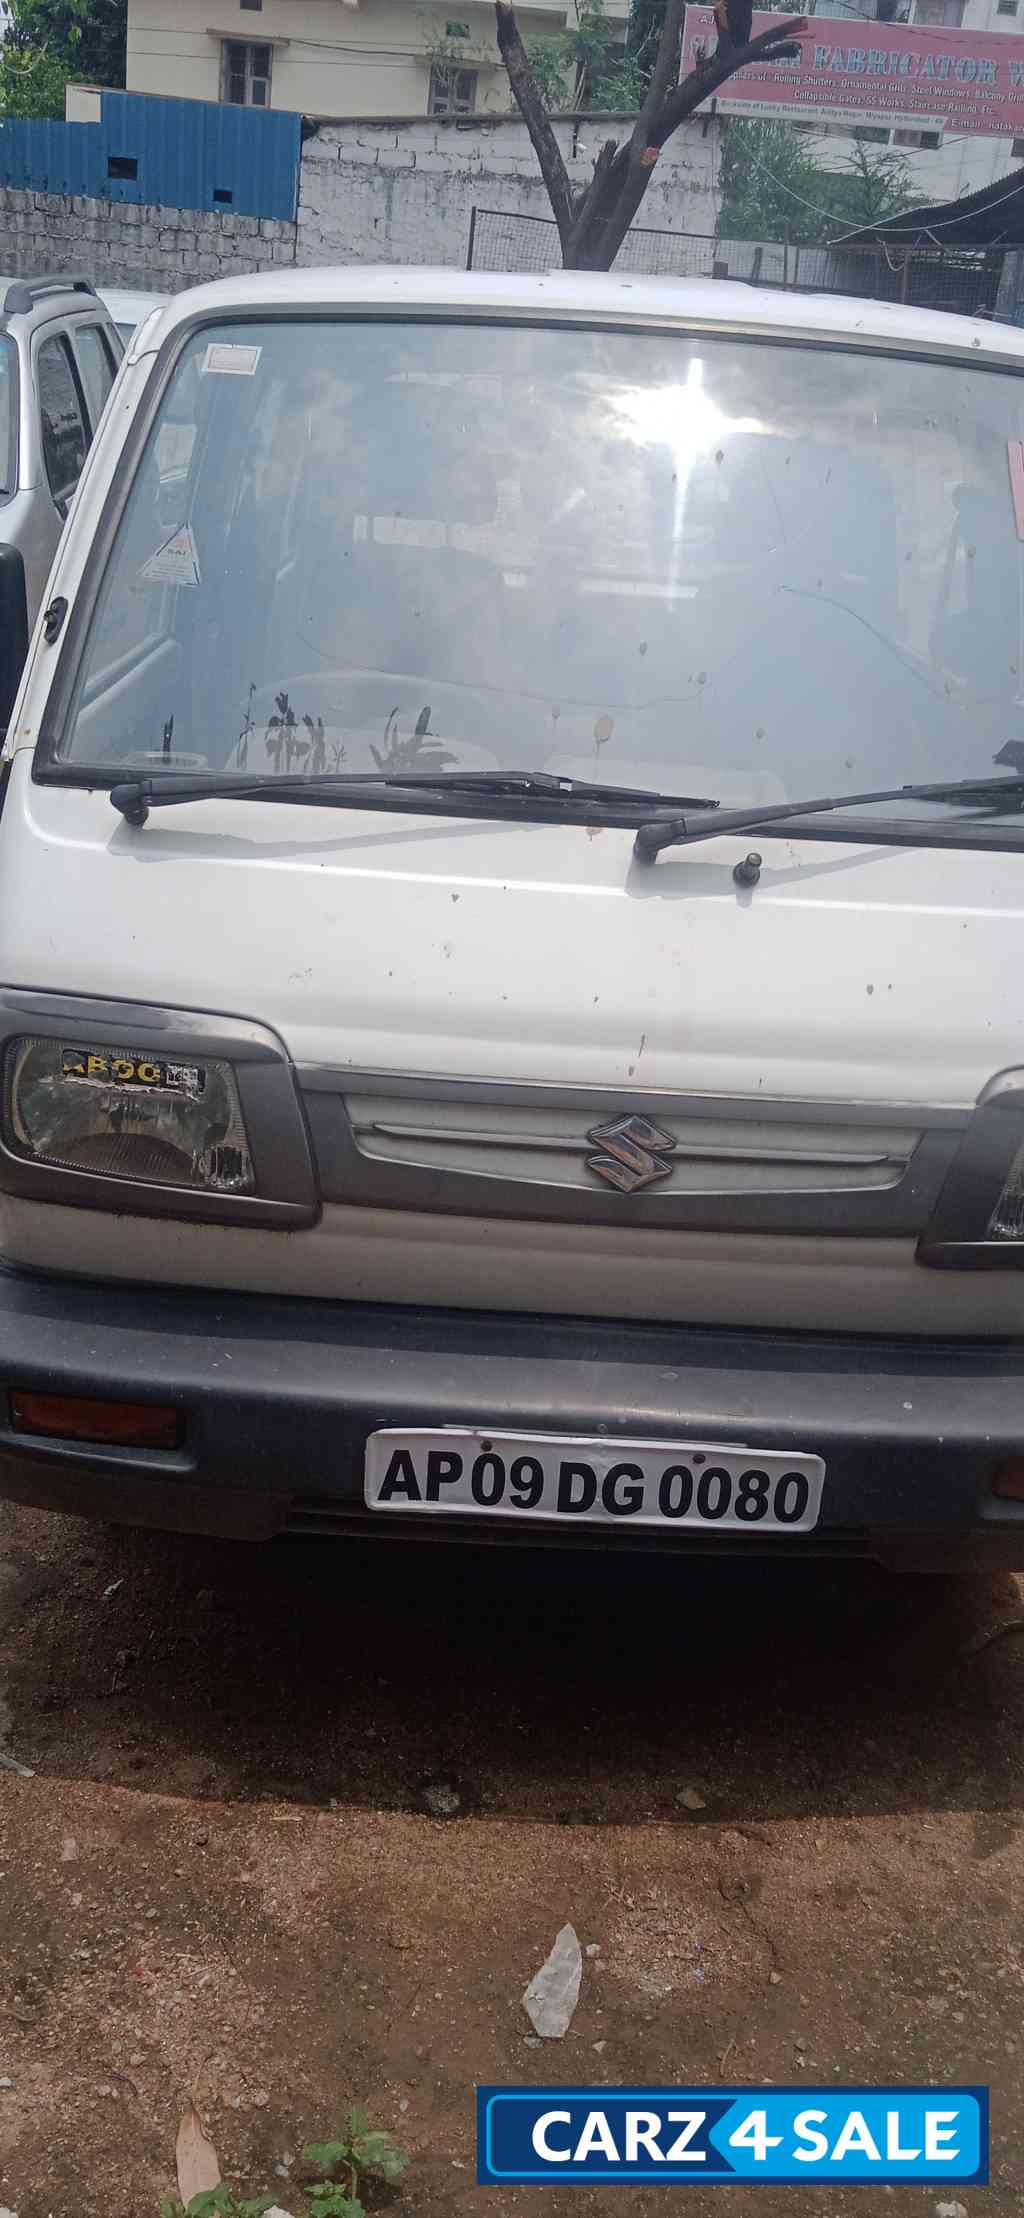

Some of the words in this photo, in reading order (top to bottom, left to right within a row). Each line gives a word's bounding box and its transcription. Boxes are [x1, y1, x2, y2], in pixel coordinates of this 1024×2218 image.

[814, 45, 998, 86] FABRICATOR
[556, 1460, 645, 1516] DG
[657, 1464, 809, 1524] 0080
